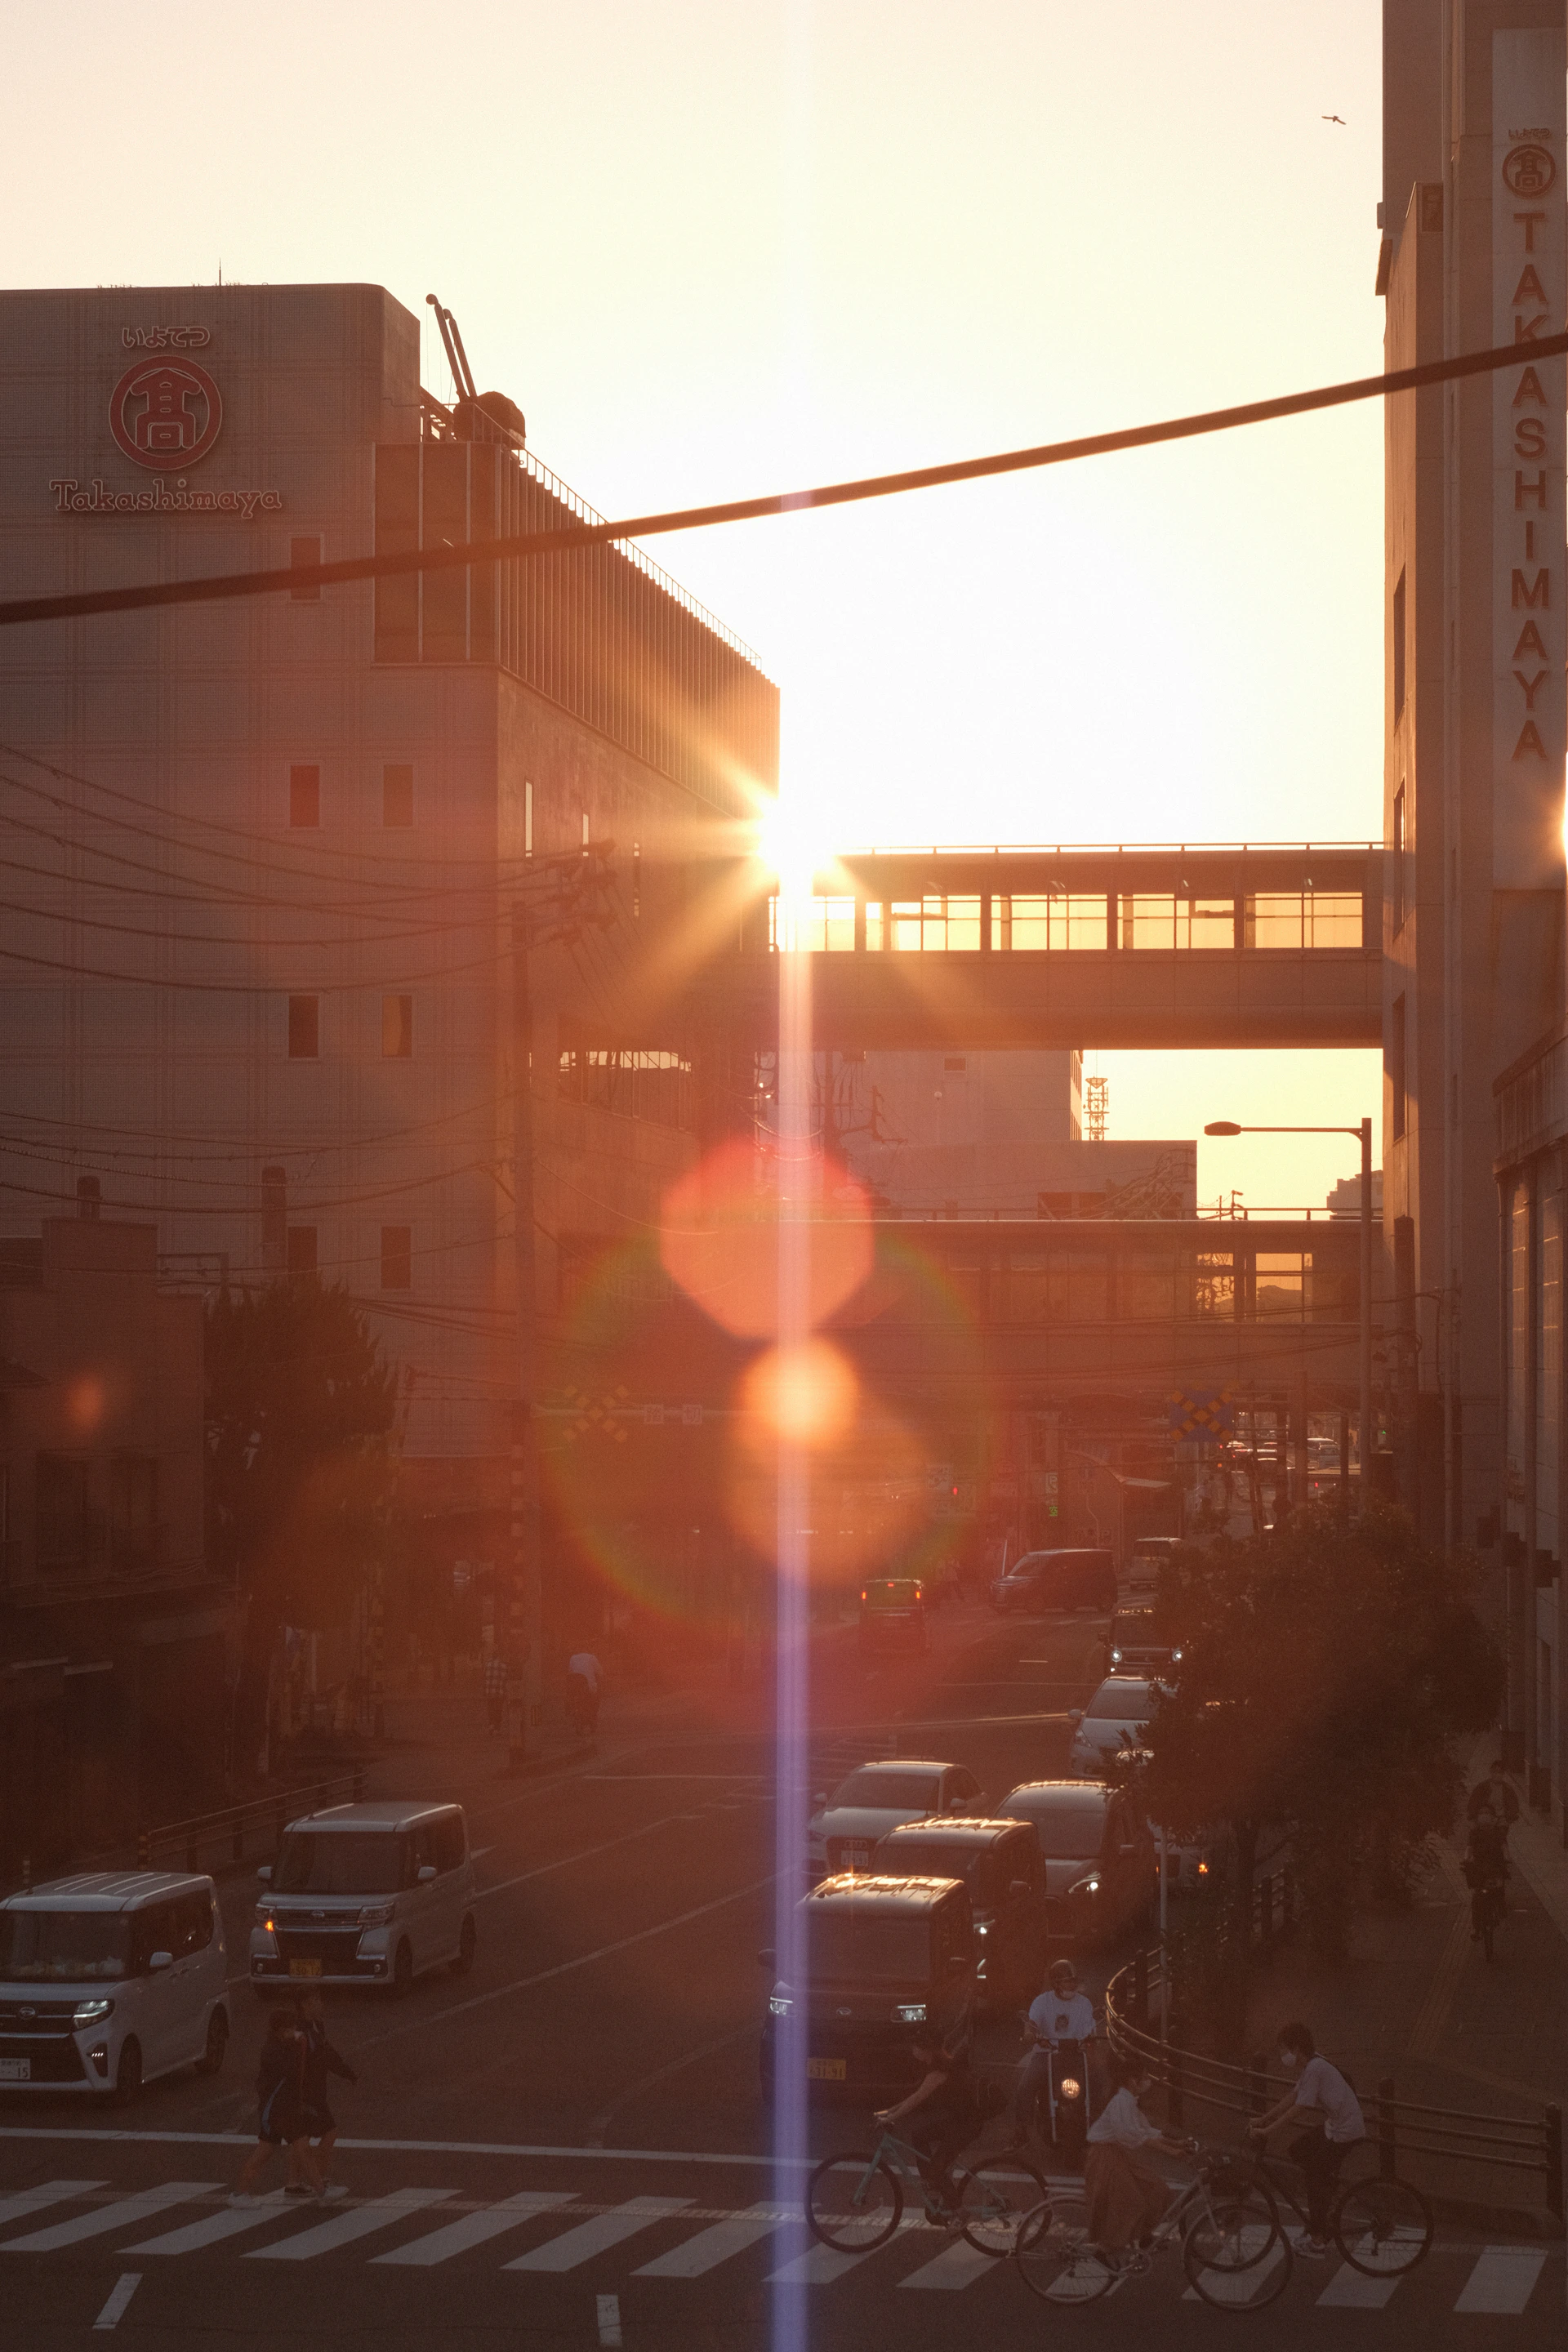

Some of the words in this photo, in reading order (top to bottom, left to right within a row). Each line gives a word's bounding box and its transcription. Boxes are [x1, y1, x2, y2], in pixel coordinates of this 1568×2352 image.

[1508, 127, 1551, 140] いよてつ
[122, 327, 210, 348] いよてつ
[49, 479, 283, 519] Takashimaya
[1510, 212, 1550, 761] TAKASHIMAYA
